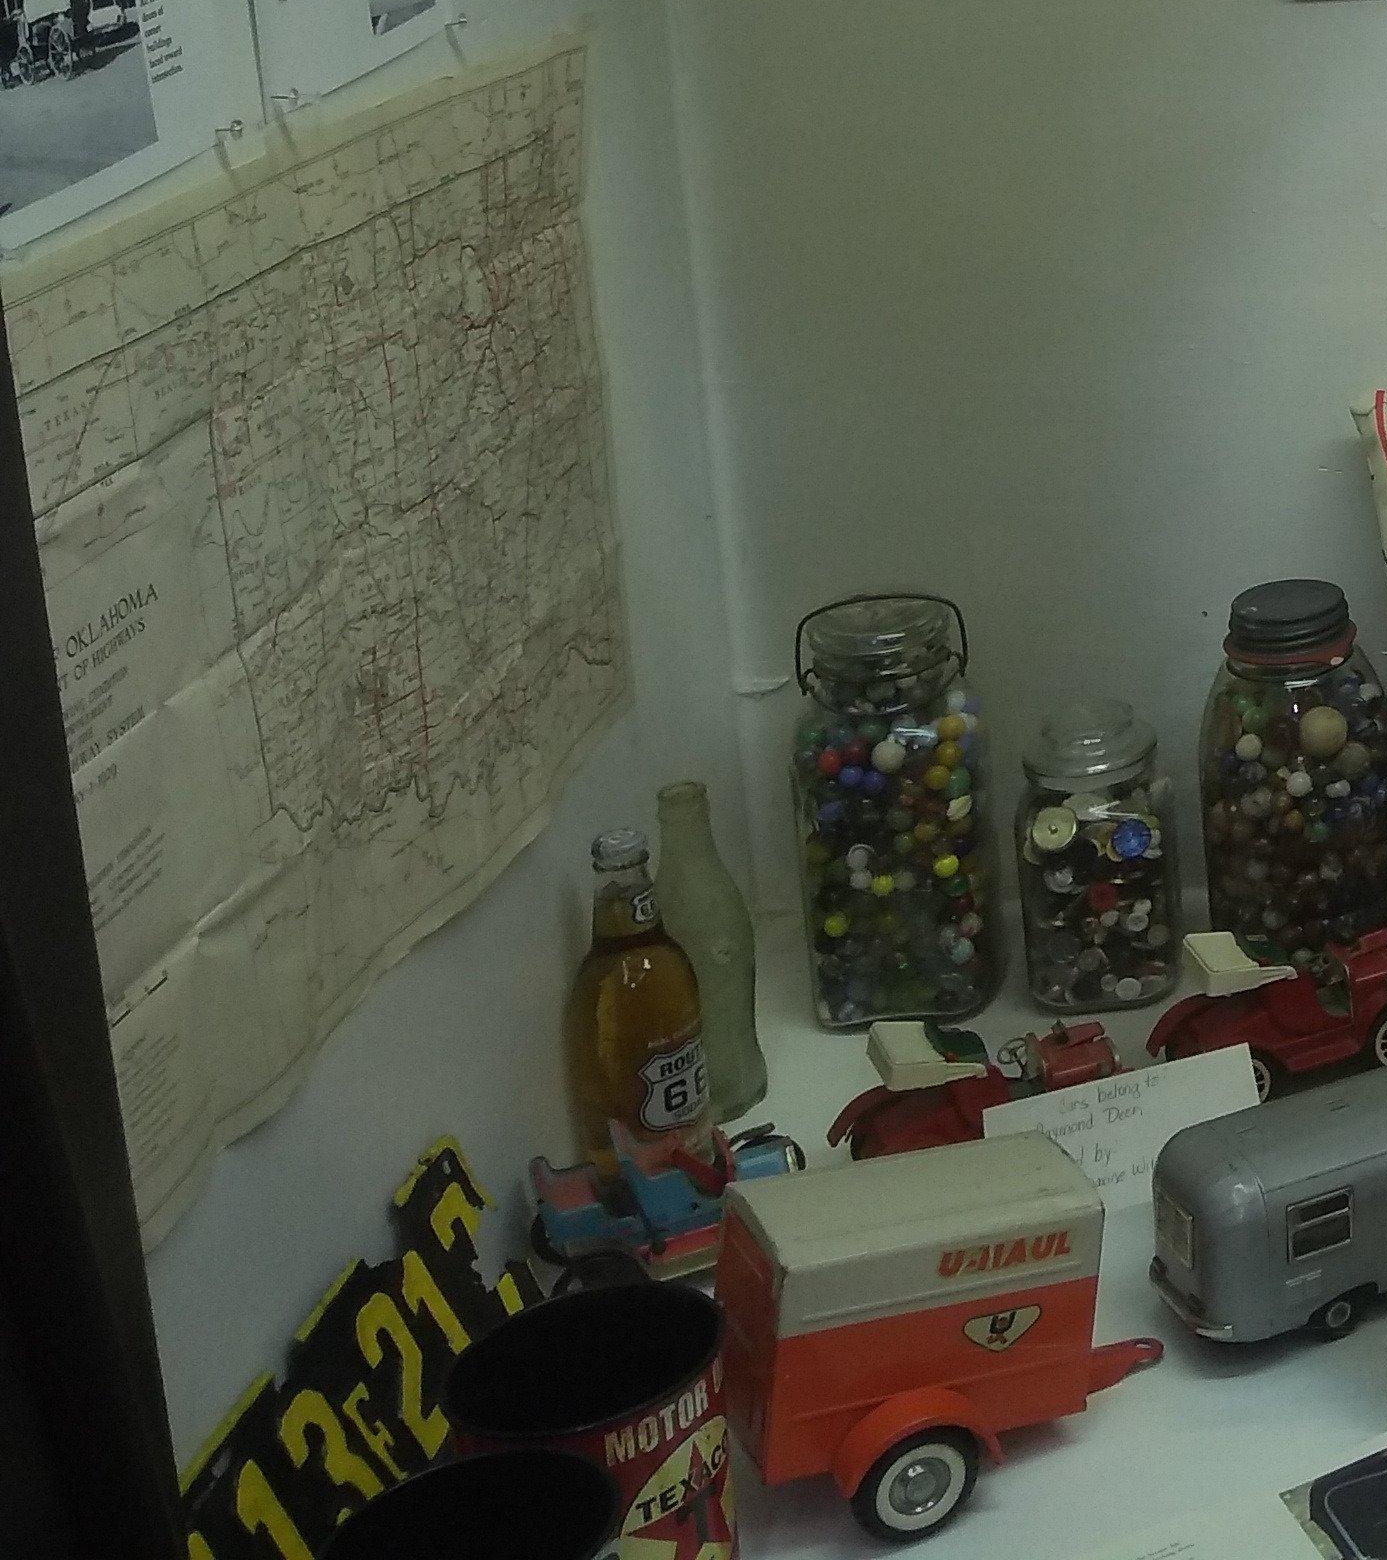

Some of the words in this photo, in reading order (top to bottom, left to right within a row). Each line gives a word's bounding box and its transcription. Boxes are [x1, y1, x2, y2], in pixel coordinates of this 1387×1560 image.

[65, 583, 160, 659] OKLAHOMA
[938, 1230, 1072, 1279] U-HAUL
[603, 1379, 710, 1468] MOTOR
